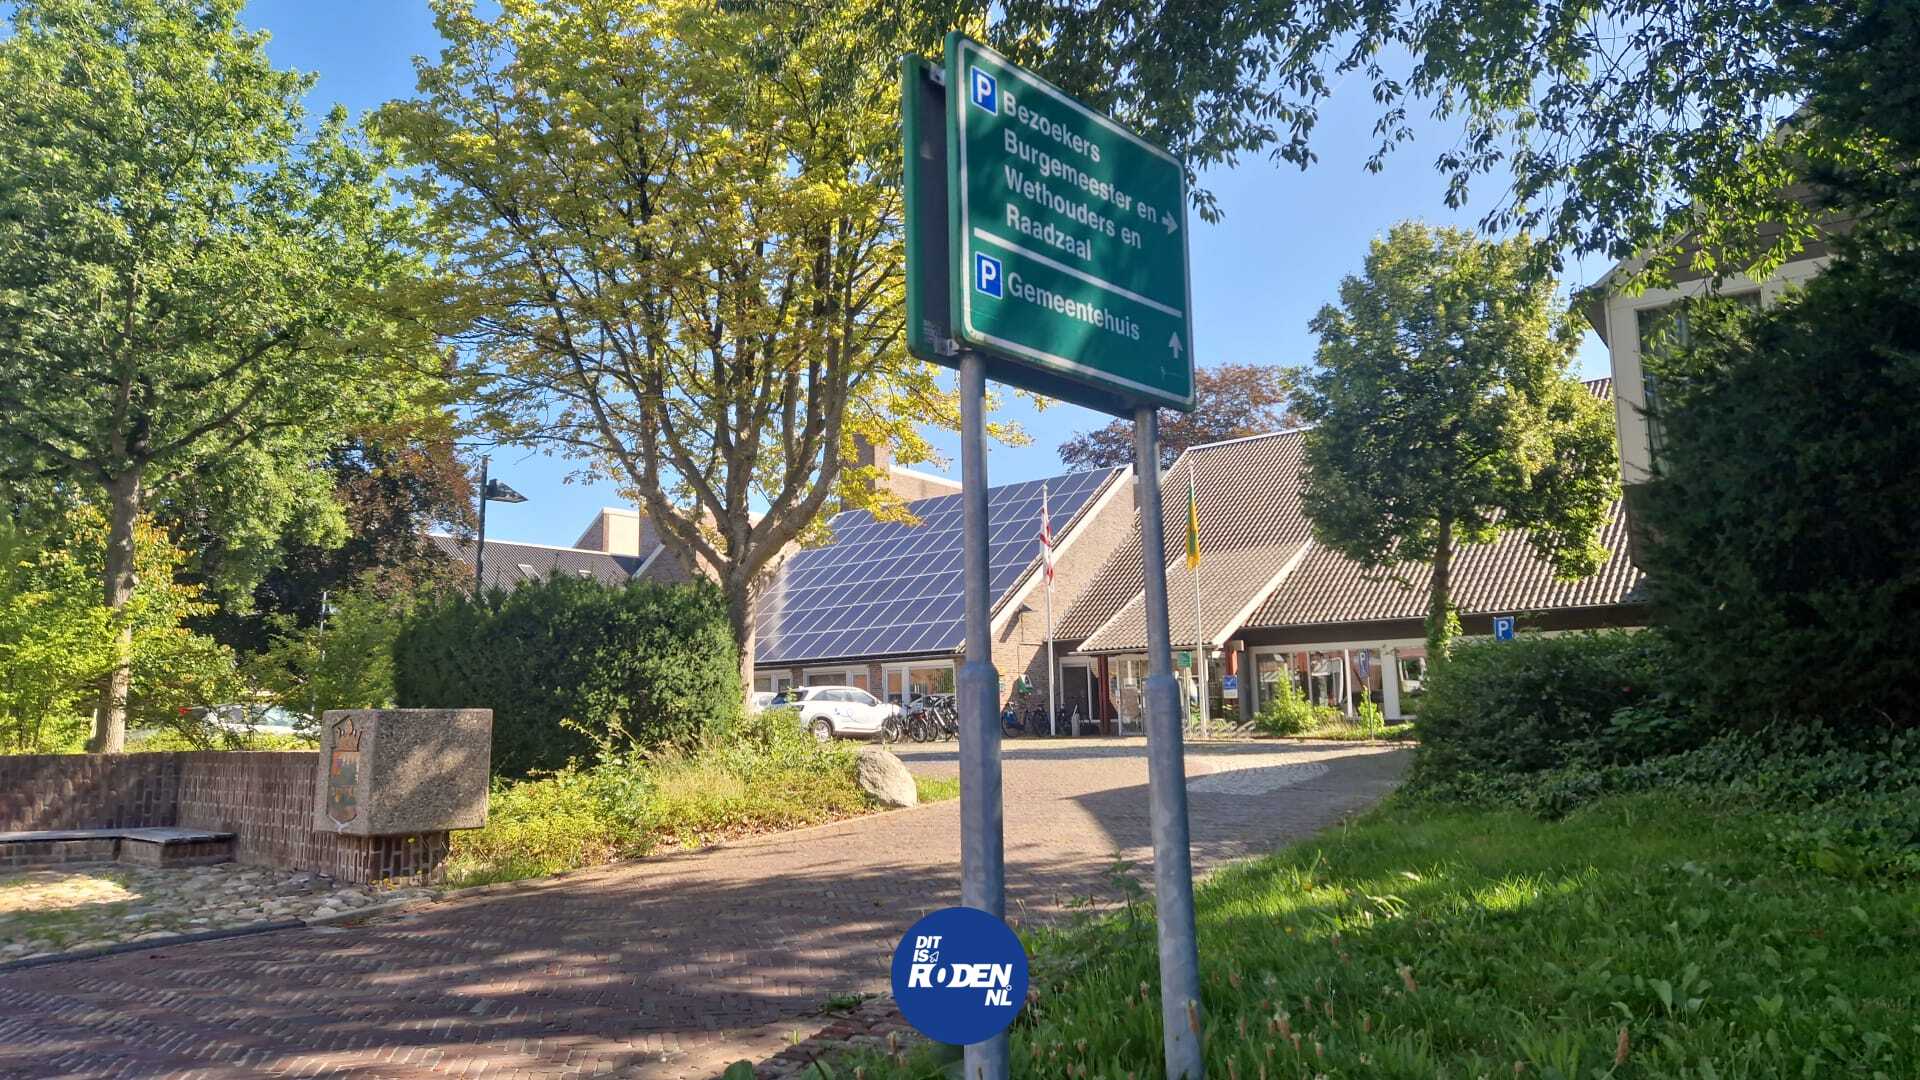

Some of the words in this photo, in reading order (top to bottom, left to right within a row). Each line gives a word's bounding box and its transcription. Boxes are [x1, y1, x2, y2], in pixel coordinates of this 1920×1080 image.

[1003, 90, 1101, 163] Bezoekers
[1004, 128, 1133, 210] Burgemeester
[1136, 200, 1158, 223] en
[1004, 165, 1116, 237] Wethouders
[1121, 228, 1142, 249] en
[1006, 203, 1093, 262] Raadzaal
[1007, 272, 1141, 341] Gemeentehuis
